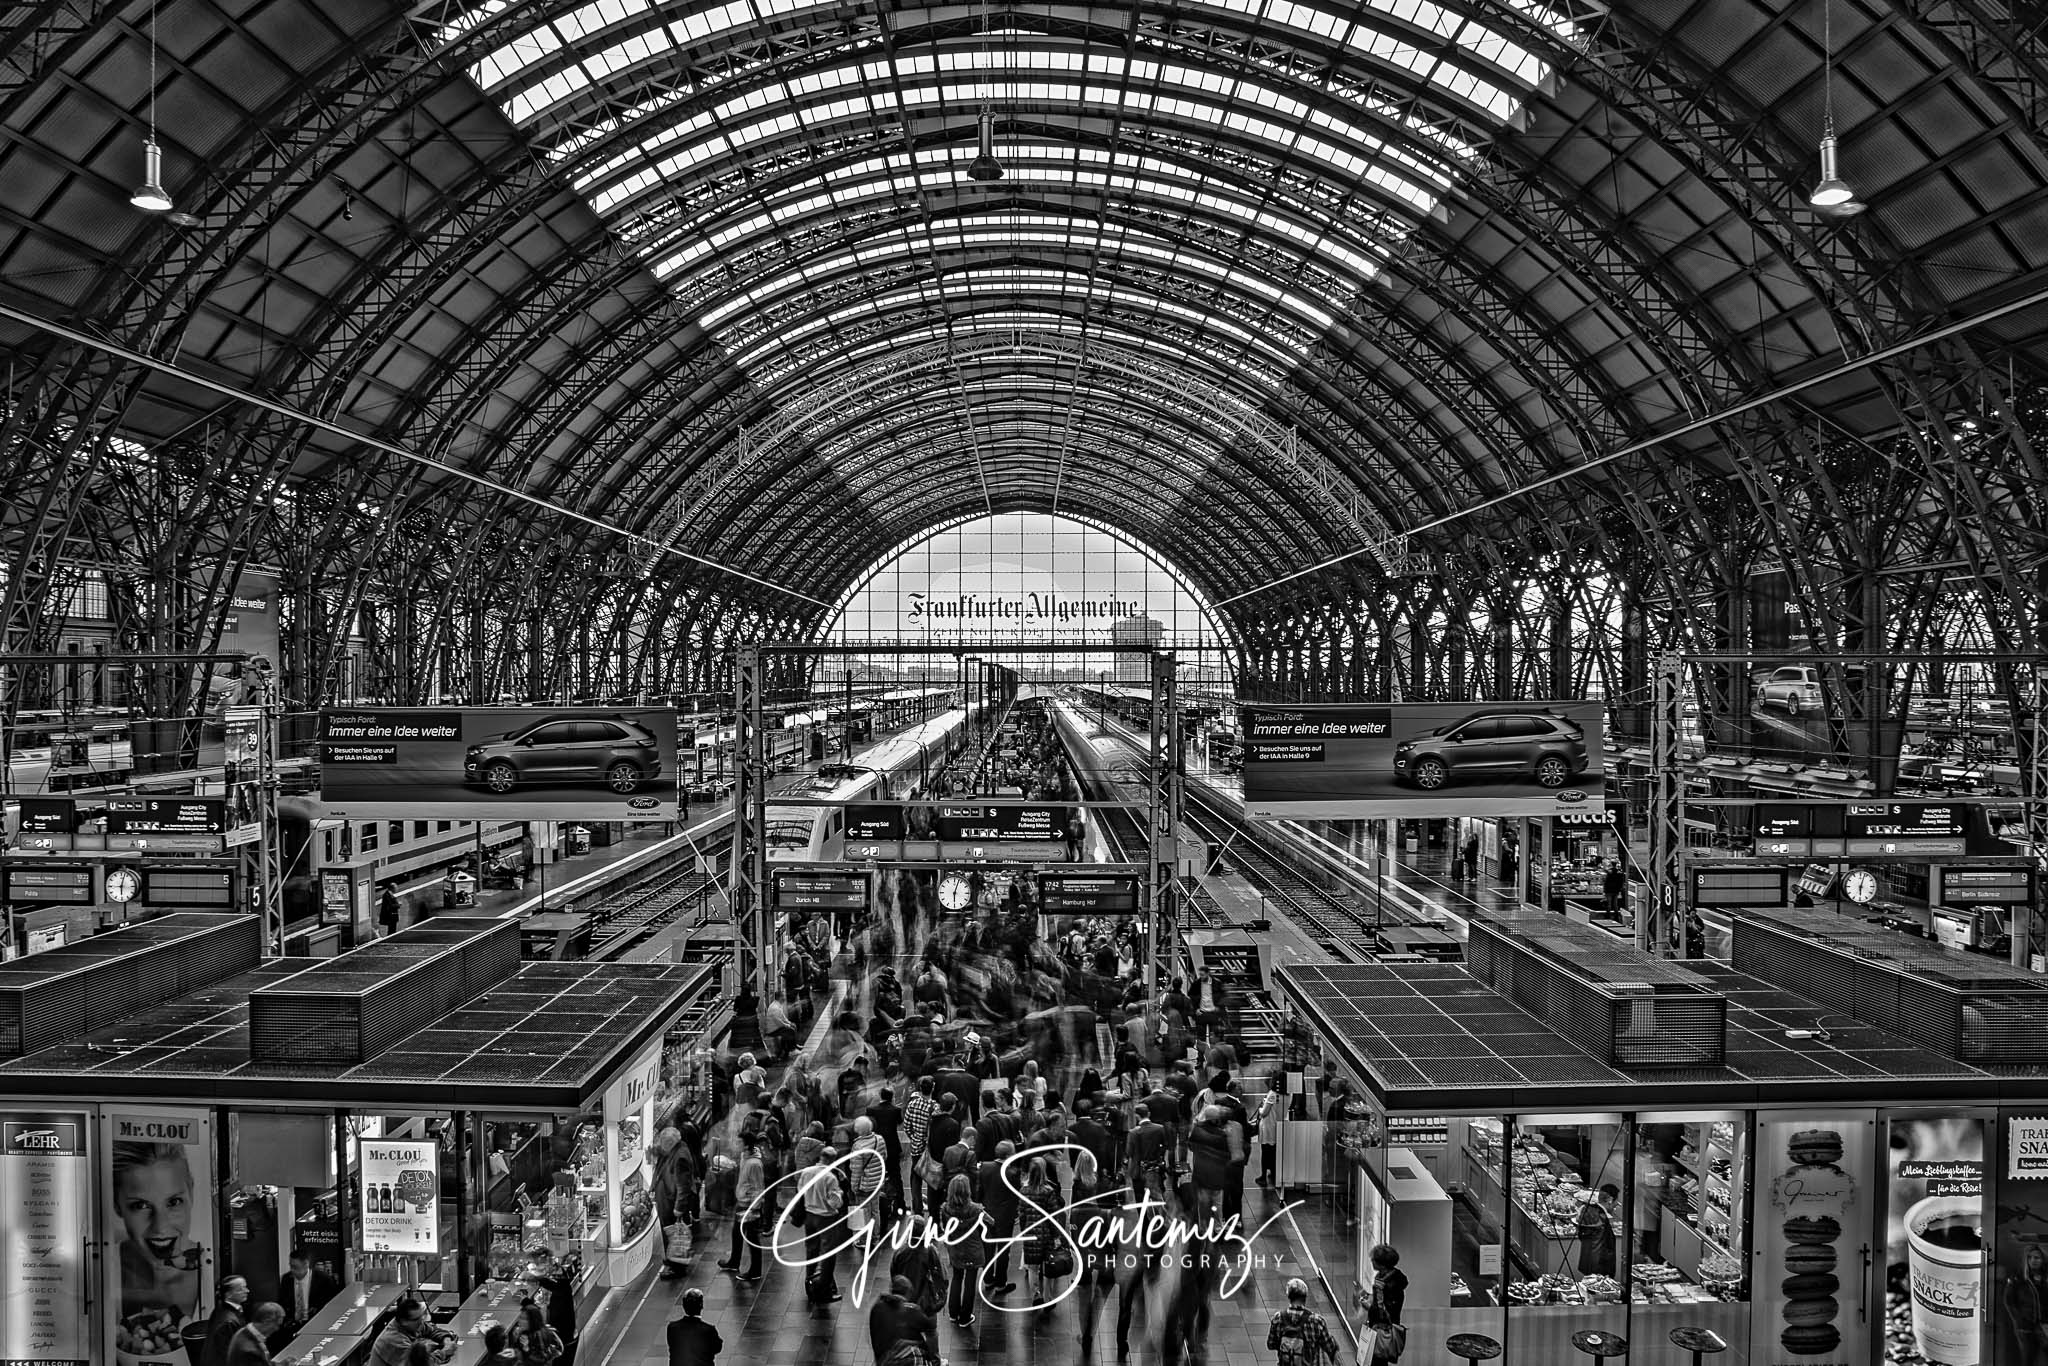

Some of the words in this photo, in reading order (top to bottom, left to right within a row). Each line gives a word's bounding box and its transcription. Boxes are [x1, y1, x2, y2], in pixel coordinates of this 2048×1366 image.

[907, 593, 1023, 624] Frankfurter
[1025, 592, 1138, 623] Allgemeine
[328, 715, 356, 724] Typisch
[357, 716, 377, 724] Ford:
[1253, 713, 1282, 722] Typisch
[1283, 713, 1304, 721] Ford:
[328, 725, 366, 737] immer
[367, 725, 392, 737] eine
[394, 725, 419, 737] Idee
[421, 725, 457, 737] weiter
[1253, 723, 1292, 735] immer
[1294, 723, 1319, 735] eine
[1321, 722, 1347, 734] Idee
[1349, 722, 1386, 734] weiter
[247, 732, 258, 745] 39
[1561, 791, 1582, 801] Ford
[110, 802, 116, 810] U
[151, 802, 159, 810] S
[634, 798, 655, 807] Ford
[944, 808, 951, 817] U
[989, 808, 997, 817] S
[1851, 806, 1858, 814] U
[1893, 805, 1901, 814] S
[222, 874, 230, 885] 5
[1697, 874, 1705, 885] 8
[2021, 873, 2028, 882] 9
[779, 878, 786, 888] 6
[1125, 880, 1133, 891] 7
[252, 886, 260, 907] 5
[1664, 885, 1672, 906] 8
[1062, 899, 1086, 907] Hamburg
[23, 1135, 60, 1149] LEHR
[1902, 1165, 1924, 1177] Mein
[401, 1171, 431, 1184] DETOX
[1937, 1183, 1949, 1196] für
[1949, 1183, 1960, 1193] die
[1960, 1182, 1982, 1193] Reise!
[365, 1217, 389, 1225] DETOX
[390, 1217, 413, 1225] DRINK
[1912, 1263, 1954, 1292] TRAFFIC
[28, 1286, 57, 1294] GUCCI
[1913, 1275, 1954, 1305] SNACK
[1941, 1308, 1955, 1316] with
[1956, 1309, 1970, 1317] love
